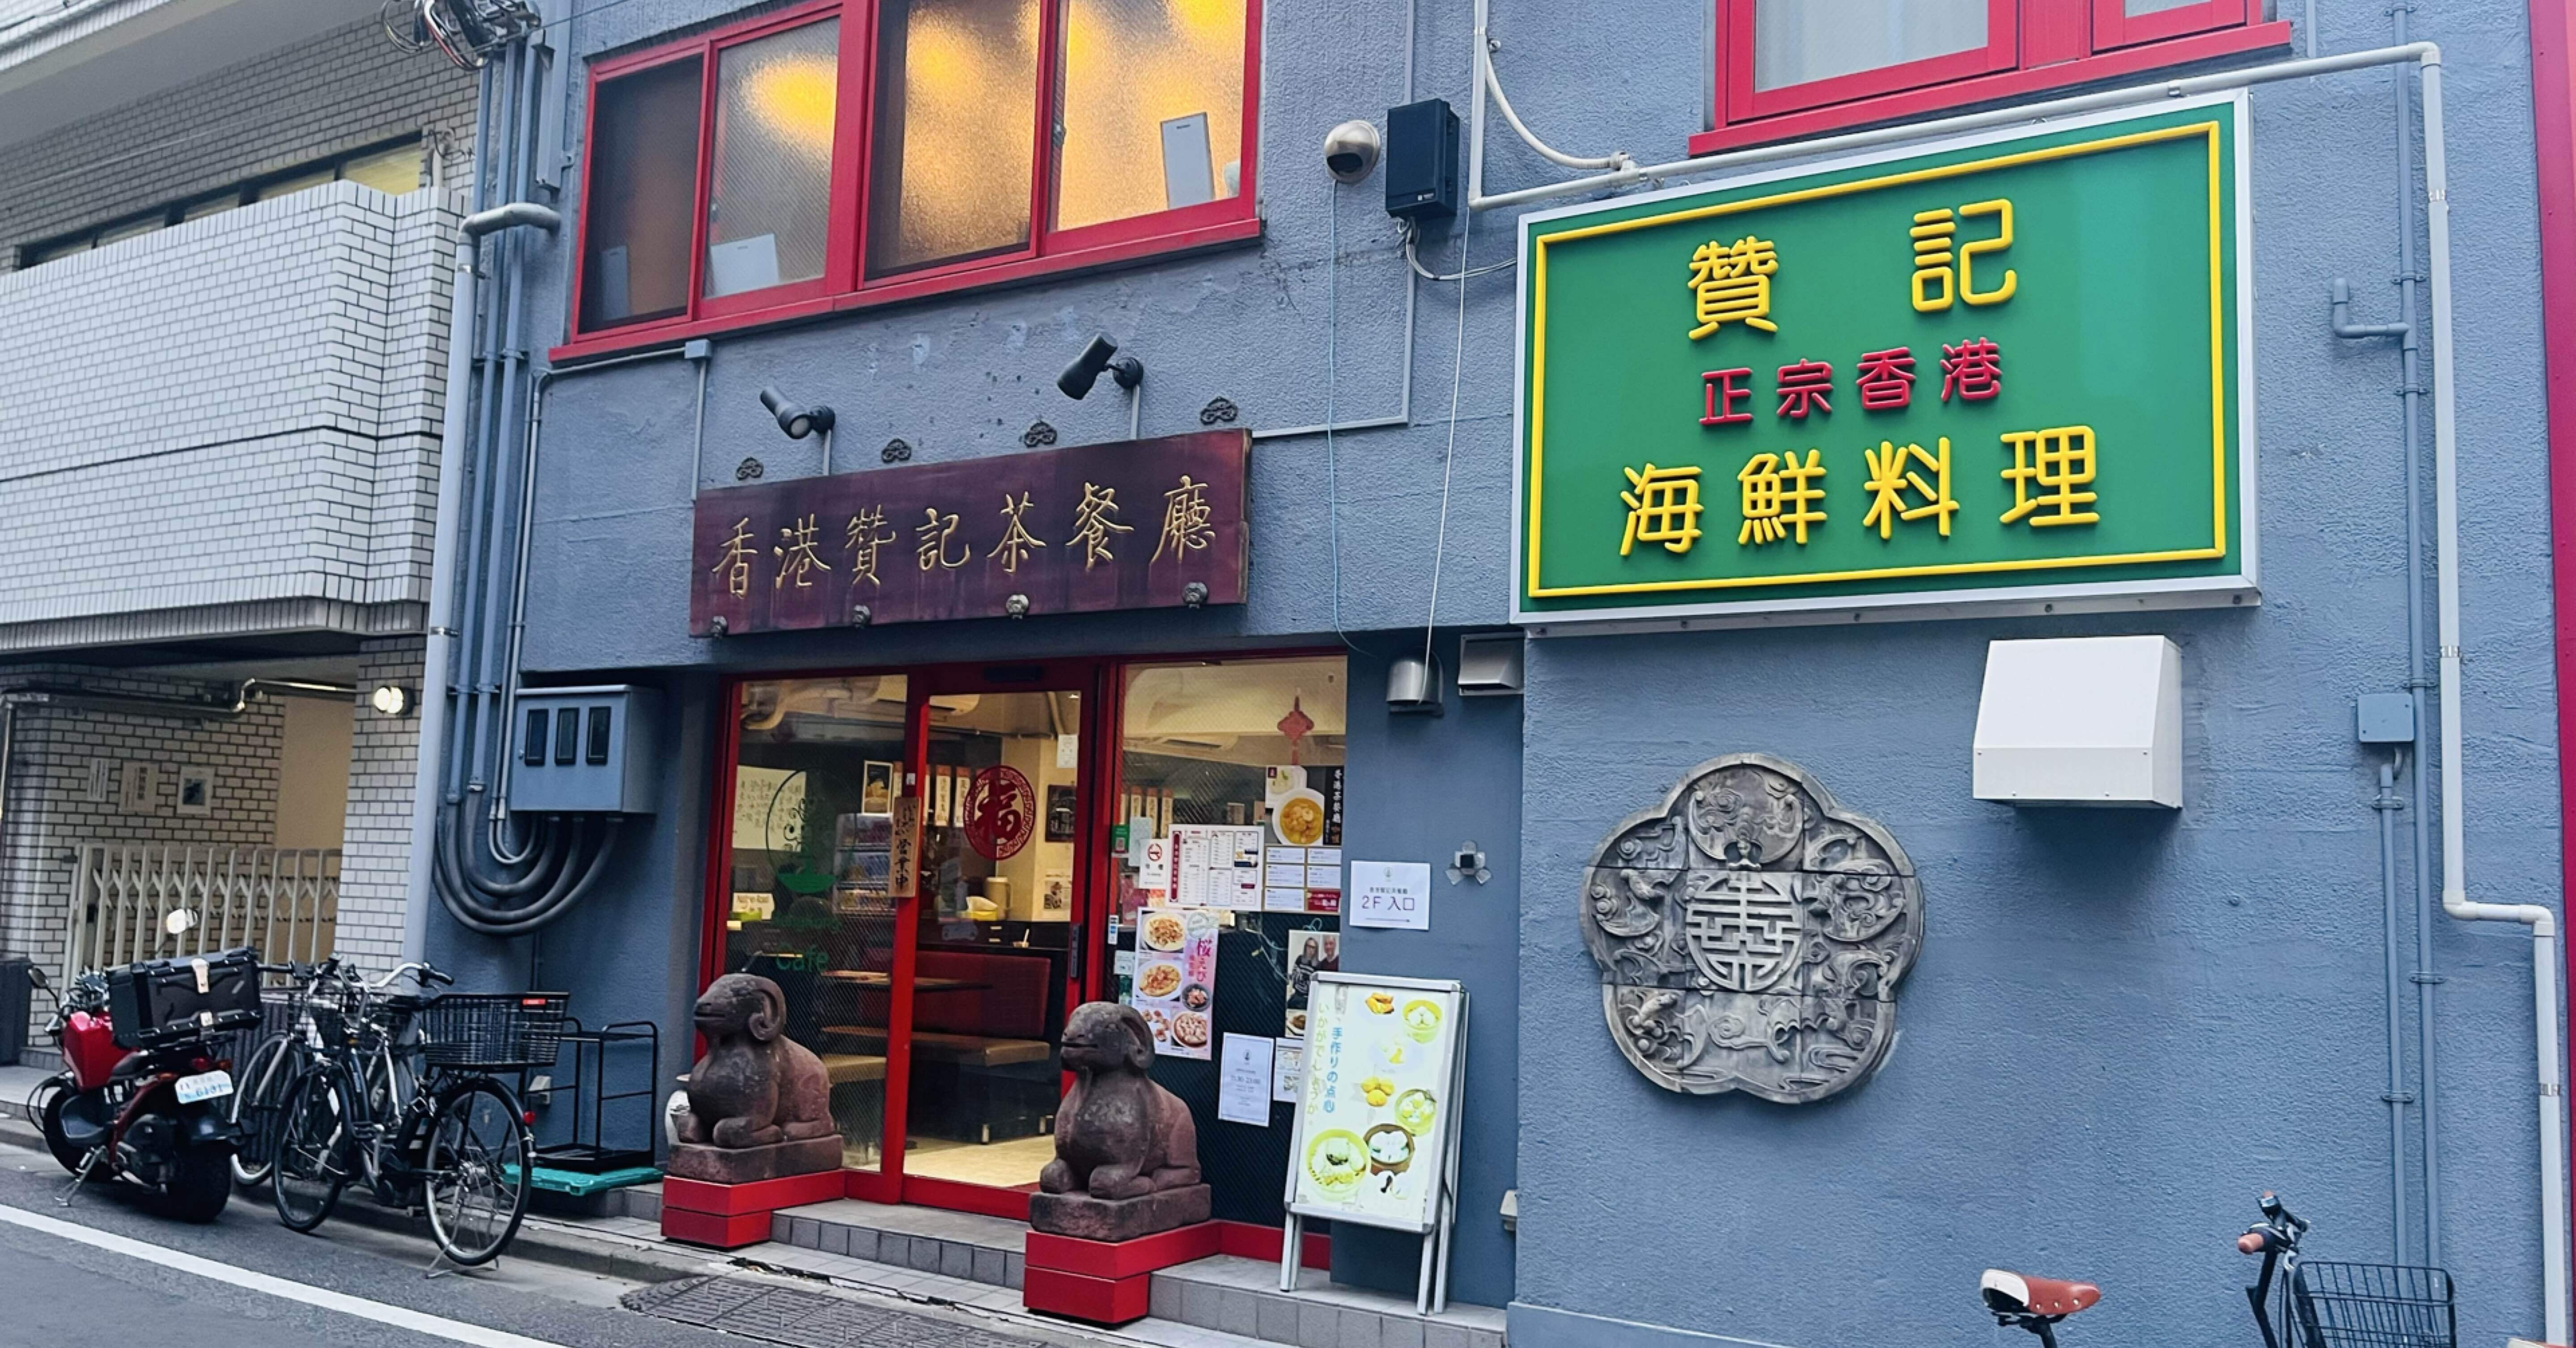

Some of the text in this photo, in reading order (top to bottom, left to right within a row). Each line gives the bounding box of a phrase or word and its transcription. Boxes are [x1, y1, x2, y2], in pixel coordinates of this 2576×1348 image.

[1699, 337, 2001, 425] 正宗香港
[1619, 425, 2100, 556] 海鮮料理
[1361, 895, 1415, 911] 2F 入口
